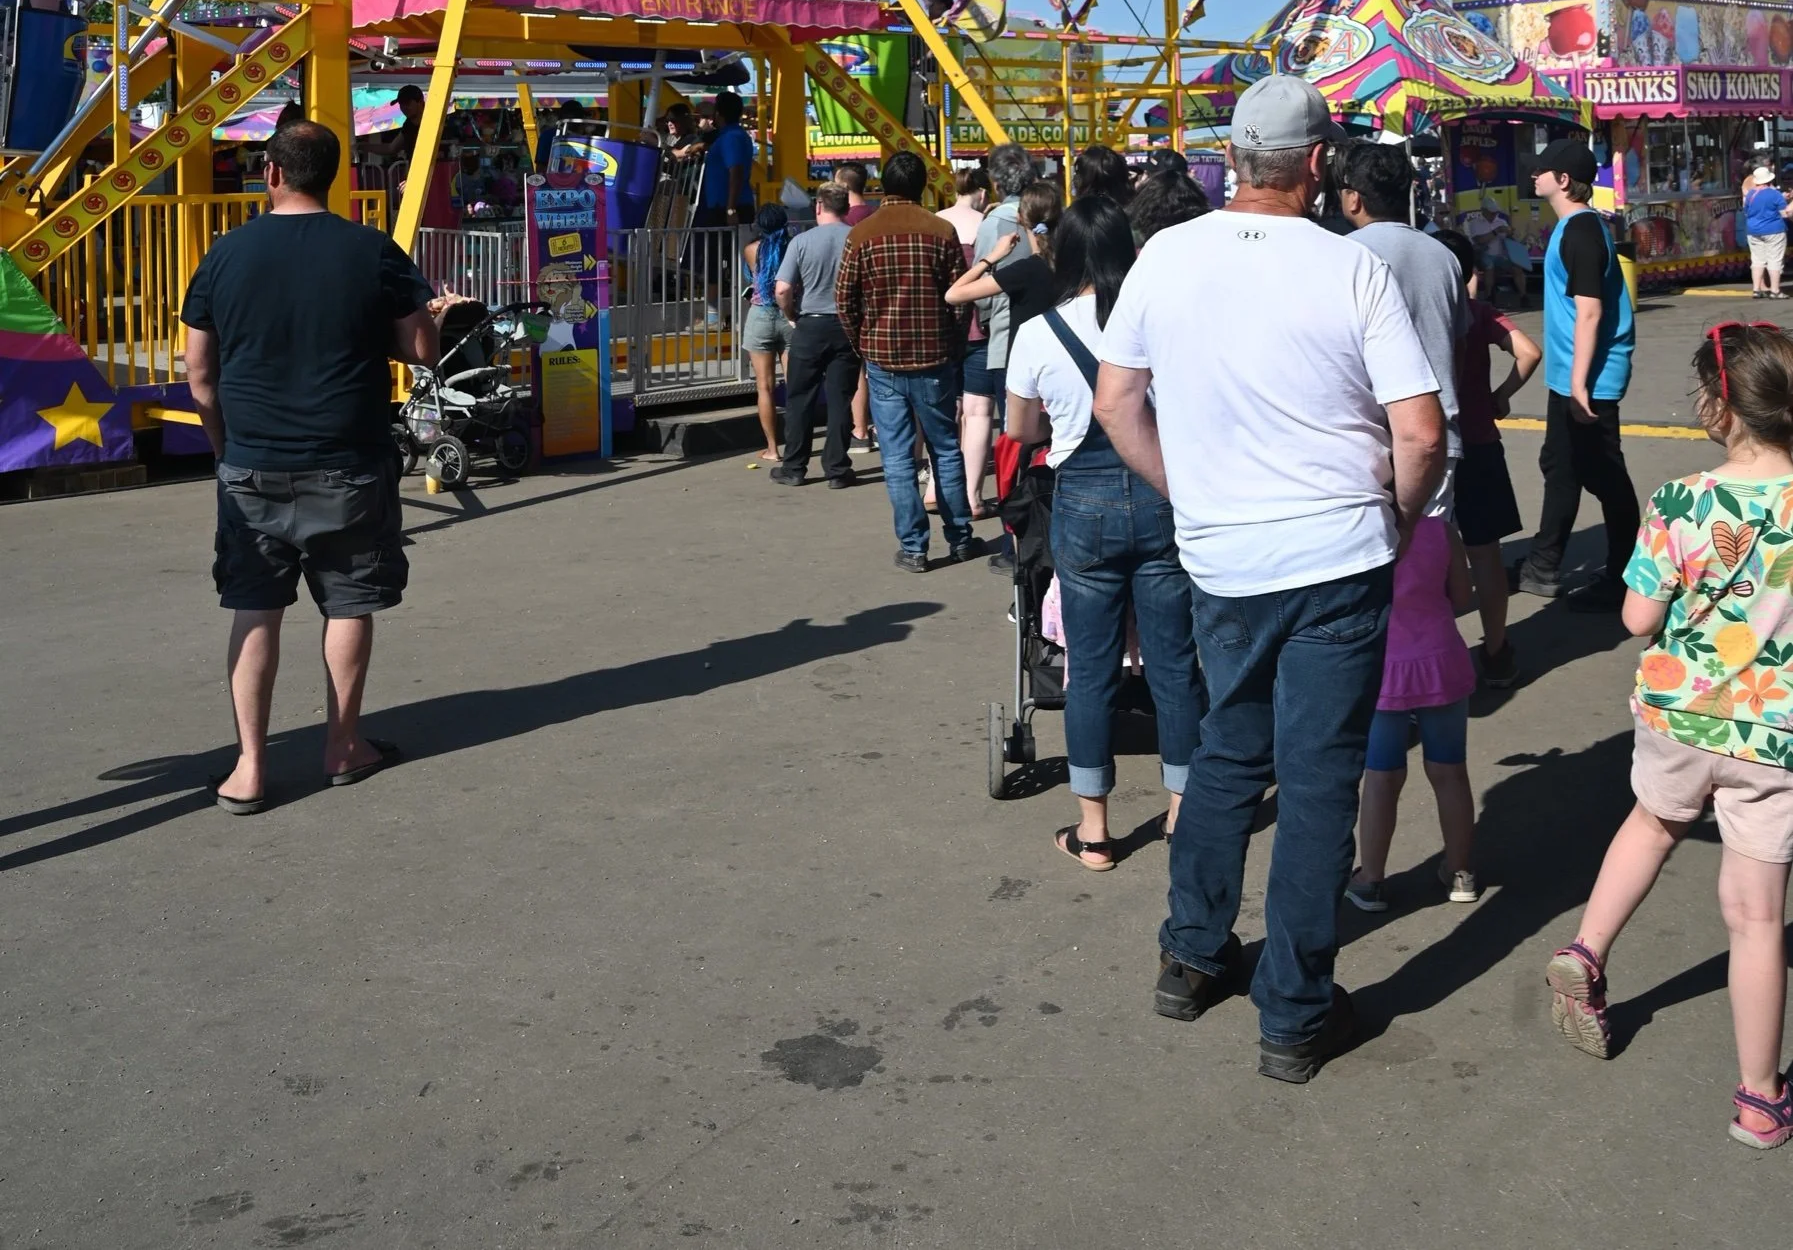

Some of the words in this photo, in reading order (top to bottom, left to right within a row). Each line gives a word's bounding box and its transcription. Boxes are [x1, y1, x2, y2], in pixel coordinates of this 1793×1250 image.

[1623, 70, 1677, 78] COLD
[1584, 76, 1677, 104] DRINKS
[1687, 72, 1721, 100] SNO
[1726, 72, 1780, 100] KONES
[1042, 125, 1083, 142] CON
[534, 190, 597, 209] EXPO
[534, 210, 598, 230] WHEEL
[549, 355, 581, 366] RULES:
